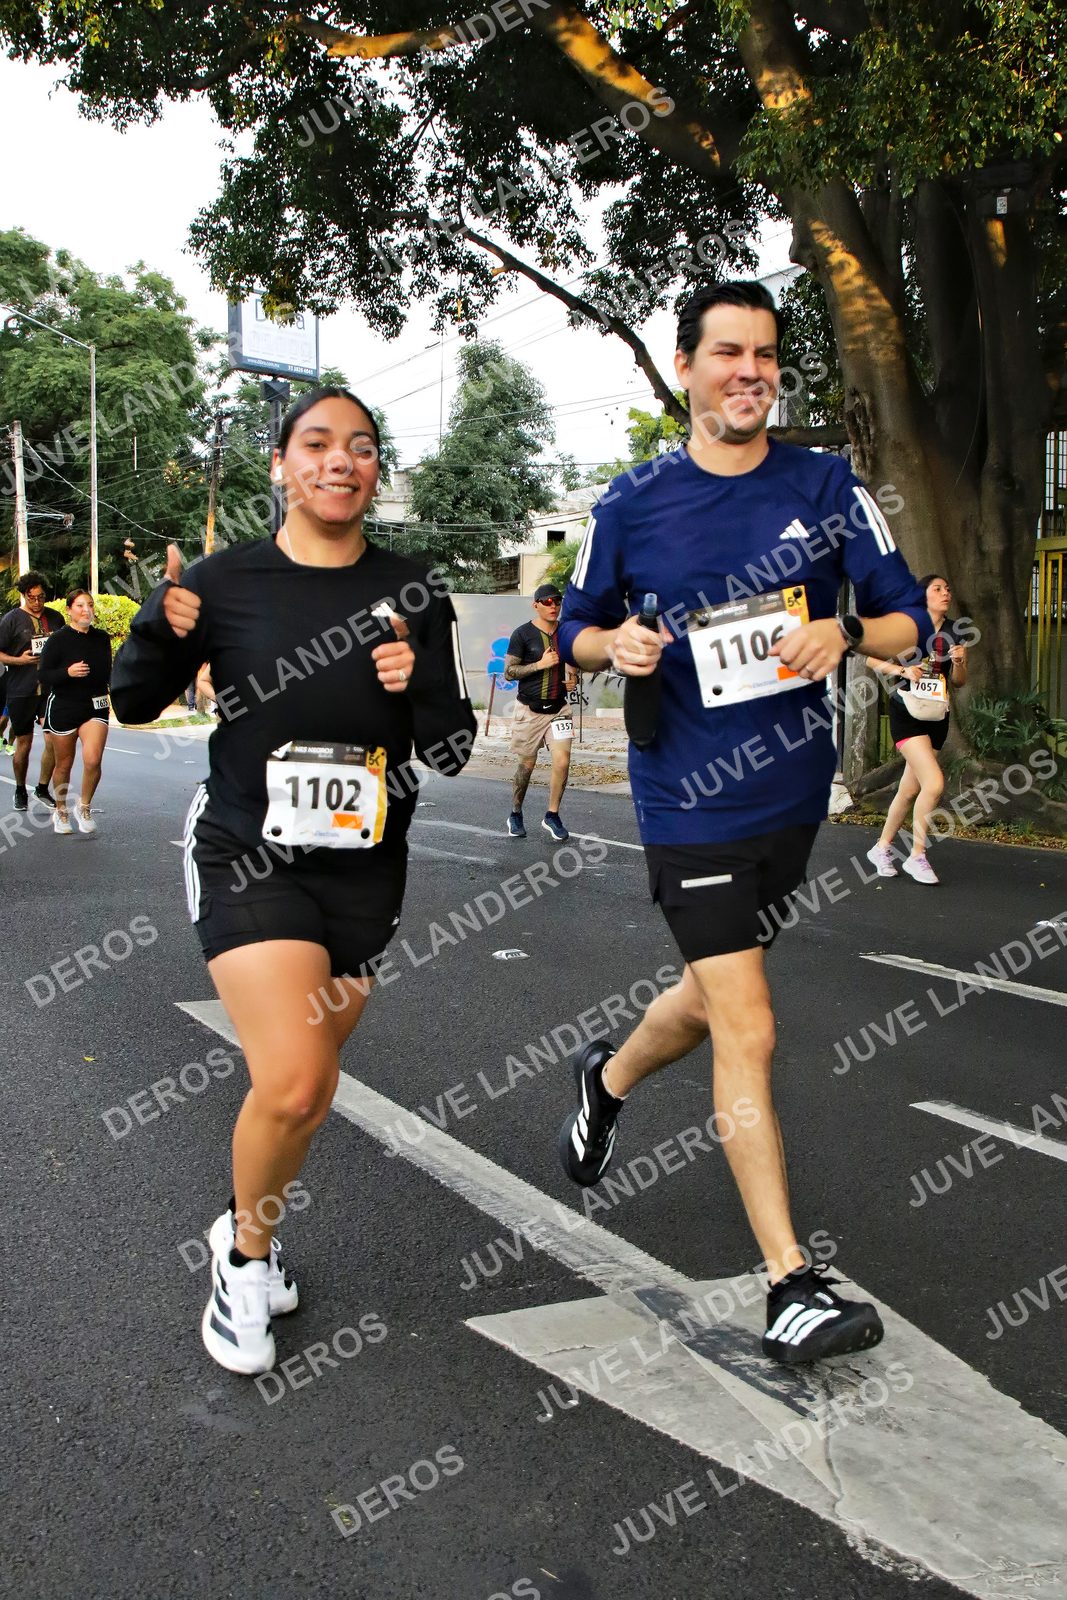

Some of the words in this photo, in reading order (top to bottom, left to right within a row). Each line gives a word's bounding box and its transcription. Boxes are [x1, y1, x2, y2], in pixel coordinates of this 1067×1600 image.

[914, 682, 938, 692] 7057
[555, 722, 574, 732] 1357
[285, 776, 361, 811] 1102
